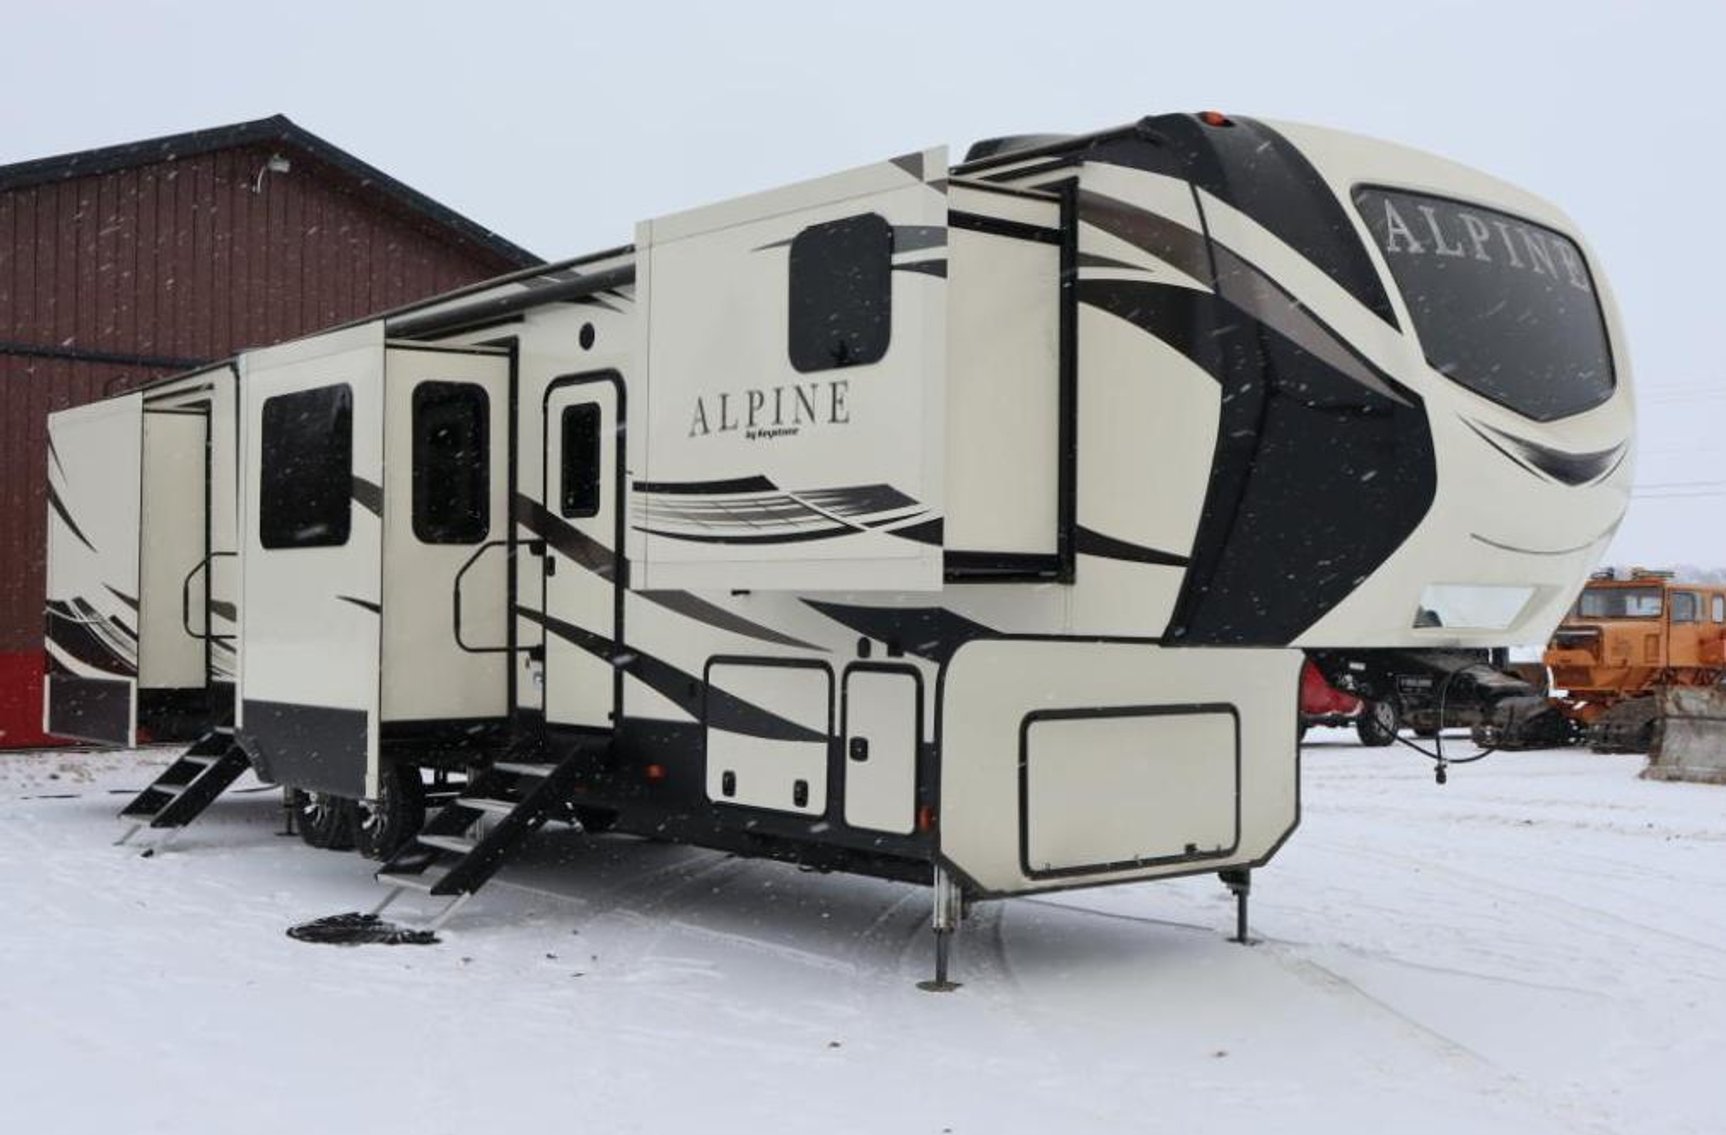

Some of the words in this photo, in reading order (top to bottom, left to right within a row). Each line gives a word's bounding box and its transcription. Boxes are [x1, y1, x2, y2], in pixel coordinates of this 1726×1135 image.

[1384, 198, 1590, 292] ALPINE
[688, 380, 851, 438] ALPINE
[745, 430, 756, 441] by
